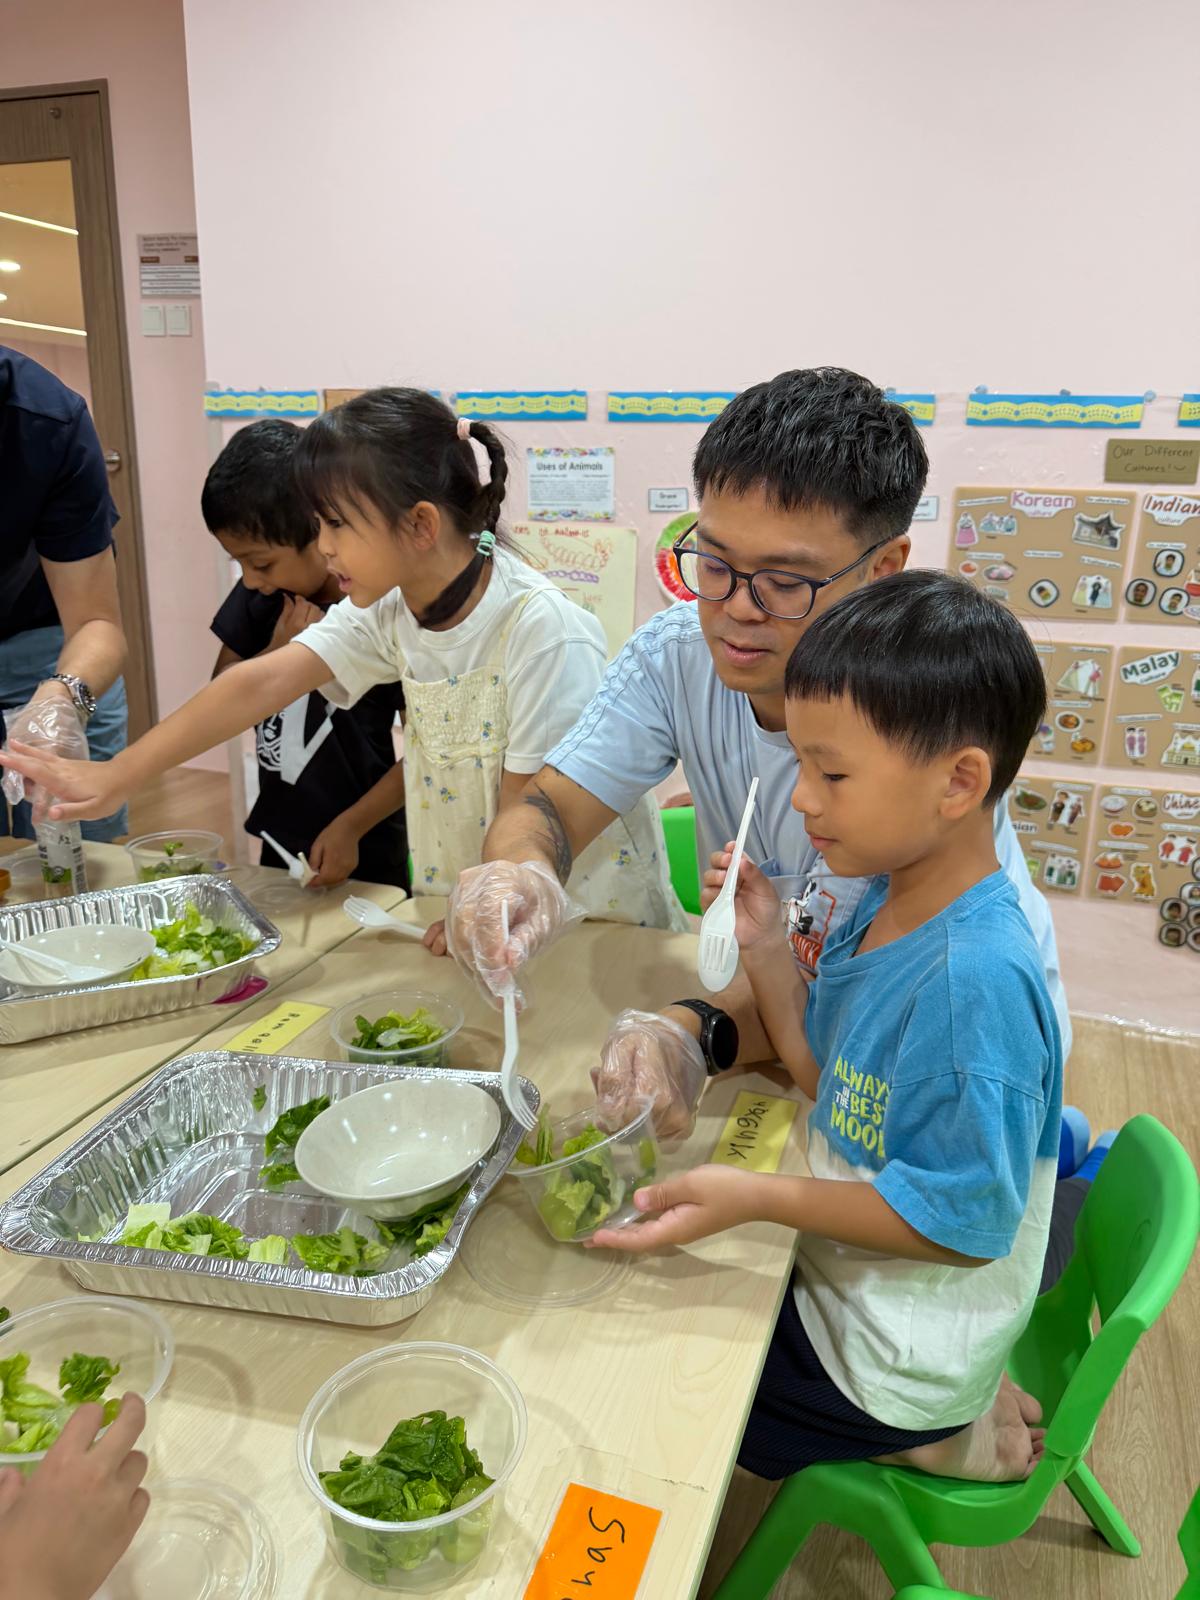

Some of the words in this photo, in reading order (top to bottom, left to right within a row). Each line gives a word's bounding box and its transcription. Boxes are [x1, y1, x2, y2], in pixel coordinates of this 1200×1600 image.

[1113, 445, 1134, 459] Our
[1144, 445, 1193, 457] Different
[536, 463, 556, 471] Uses
[558, 462, 567, 471] of
[569, 462, 603, 471] Animals
[1012, 491, 1074, 508] Korean
[1145, 495, 1200, 514] Indian
[1122, 652, 1179, 680] Malay
